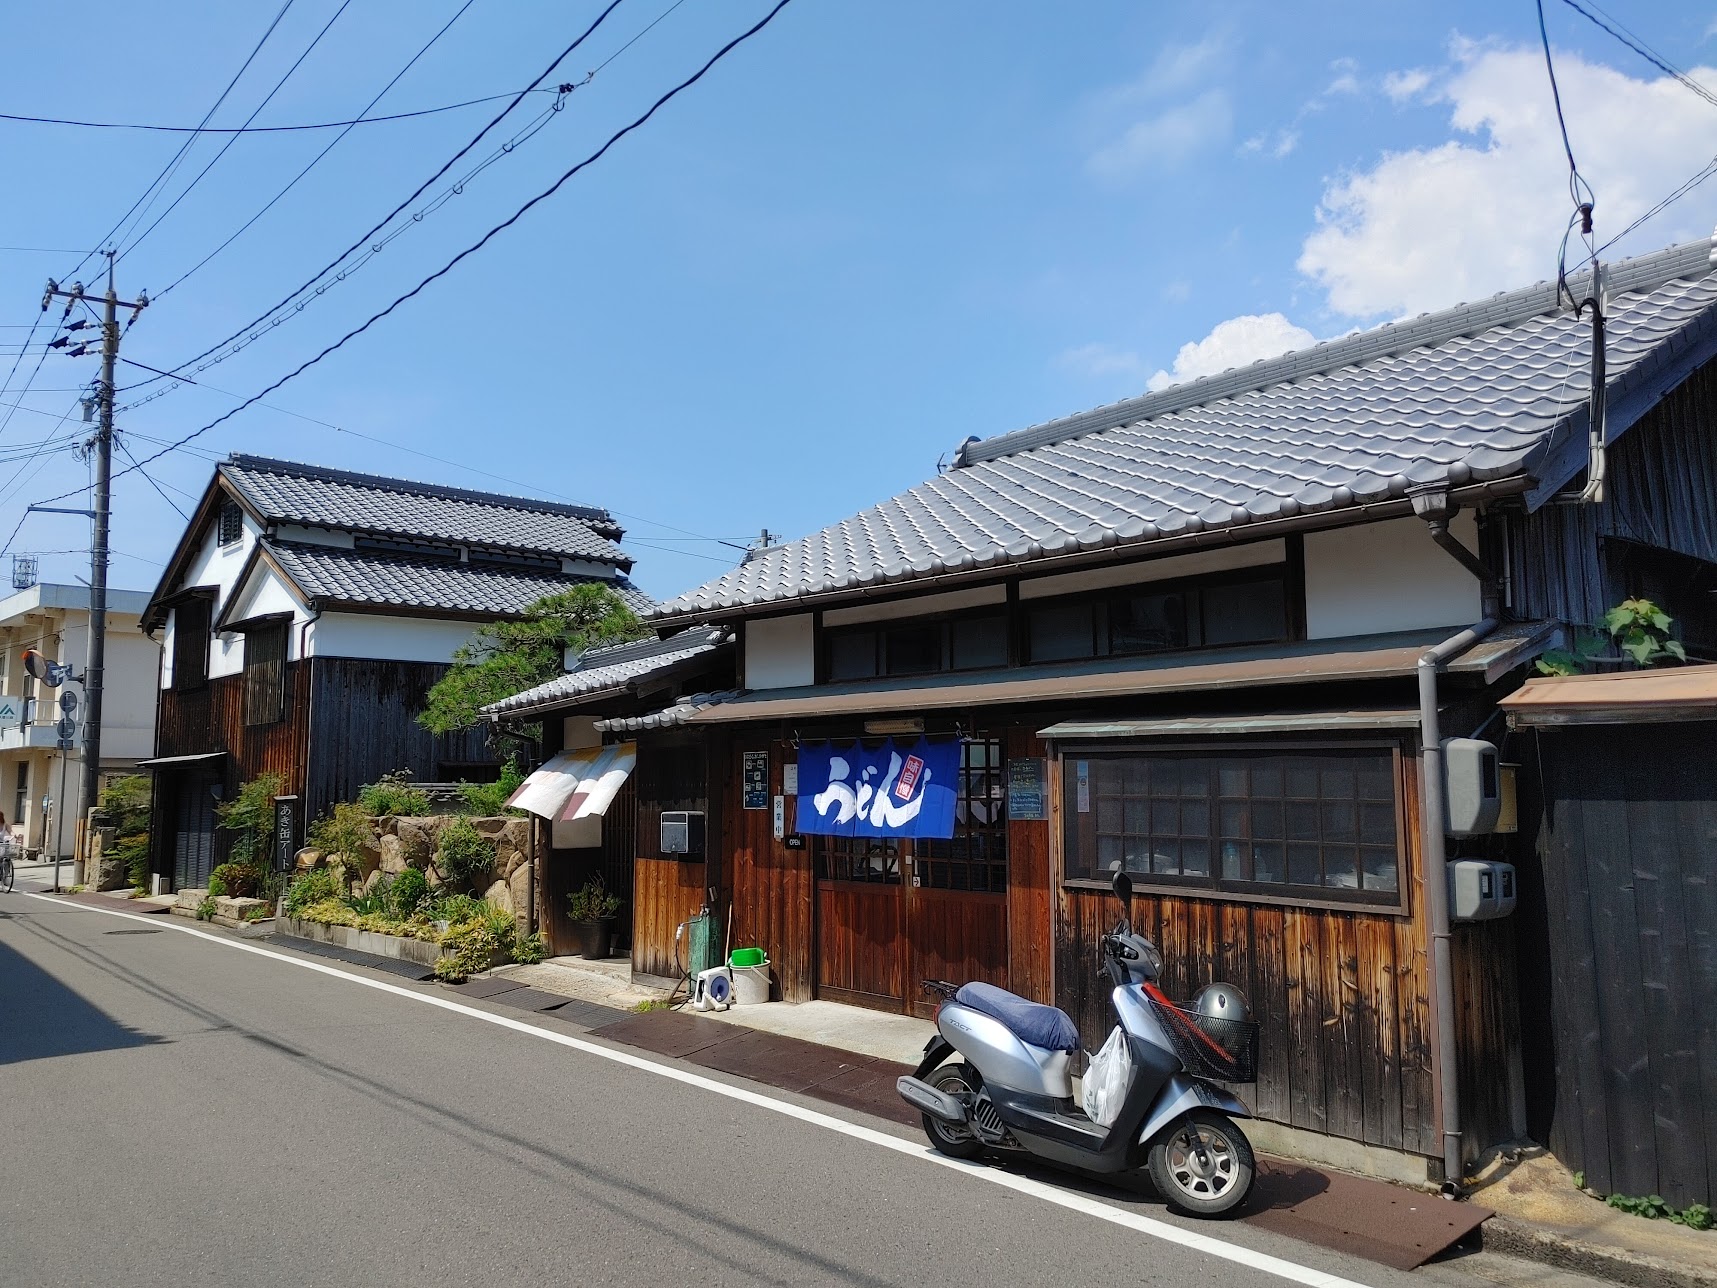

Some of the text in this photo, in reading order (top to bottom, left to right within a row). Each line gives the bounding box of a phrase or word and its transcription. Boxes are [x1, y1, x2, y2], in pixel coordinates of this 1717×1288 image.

[813, 750, 933, 828] うどん
[899, 759, 920, 798] 味自慢
[279, 804, 292, 870] あき缶アート
[789, 838, 801, 846] OPEN
[949, 1018, 973, 1032] TACT
